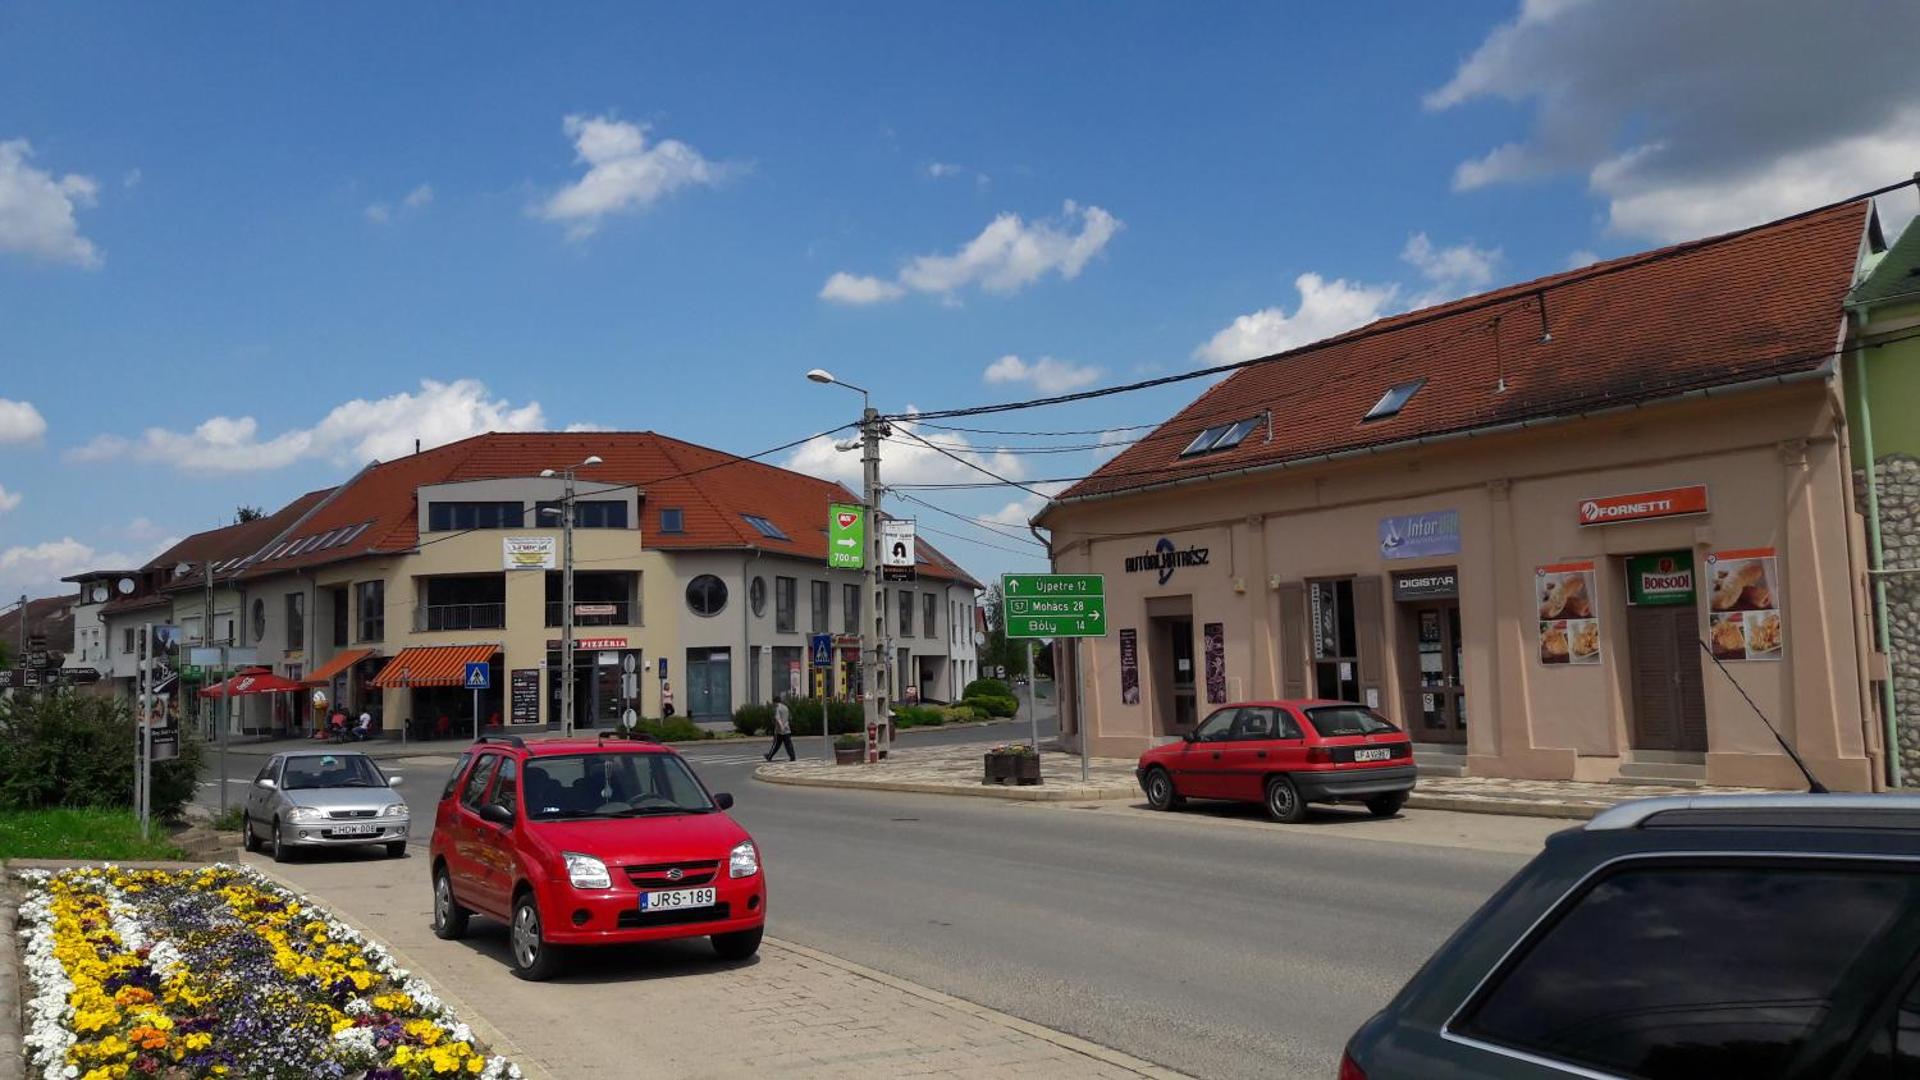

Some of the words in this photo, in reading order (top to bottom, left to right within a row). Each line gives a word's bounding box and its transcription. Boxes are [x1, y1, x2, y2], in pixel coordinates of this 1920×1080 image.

[1599, 500, 1671, 517] FORNETTI
[834, 552, 849, 561] 700
[1036, 578, 1074, 593] Újpetre
[1077, 580, 1087, 591] 12
[1400, 576, 1454, 588] DIGISTAR
[1644, 574, 1689, 589] BORSODI
[1073, 601, 1084, 612] 28
[1028, 619, 1057, 633] Bóly
[1076, 620, 1085, 631] 14
[651, 889, 713, 907] JRS-189
